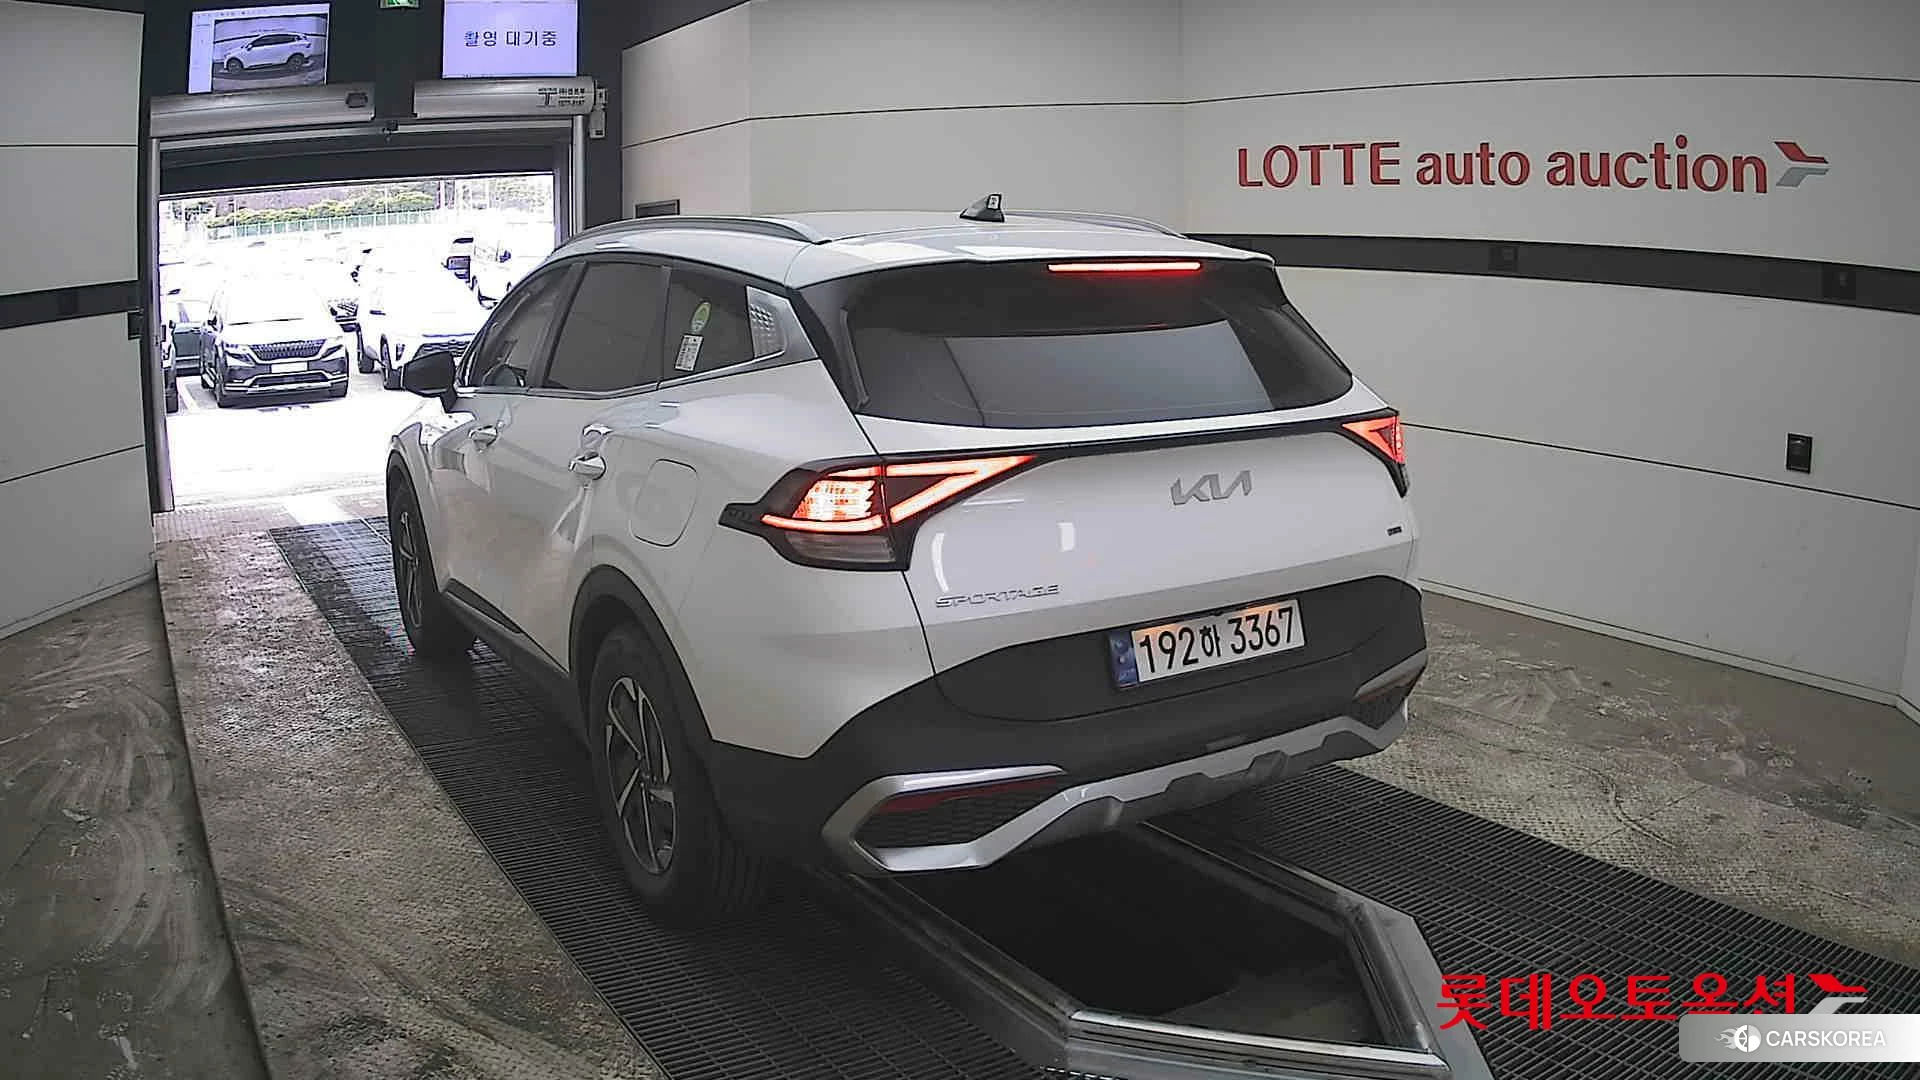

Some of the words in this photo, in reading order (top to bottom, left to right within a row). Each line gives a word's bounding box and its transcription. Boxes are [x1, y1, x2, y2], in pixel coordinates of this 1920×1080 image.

[504, 30, 557, 47] 대기중
[1238, 142, 1400, 188] LOTTE
[1416, 142, 1531, 186] auto
[1546, 136, 1768, 194] auction
[1171, 470, 1252, 505] KIA
[936, 584, 1059, 608] SPORTAGE
[1139, 622, 1221, 674] 192하
[1227, 606, 1293, 655] 3367
